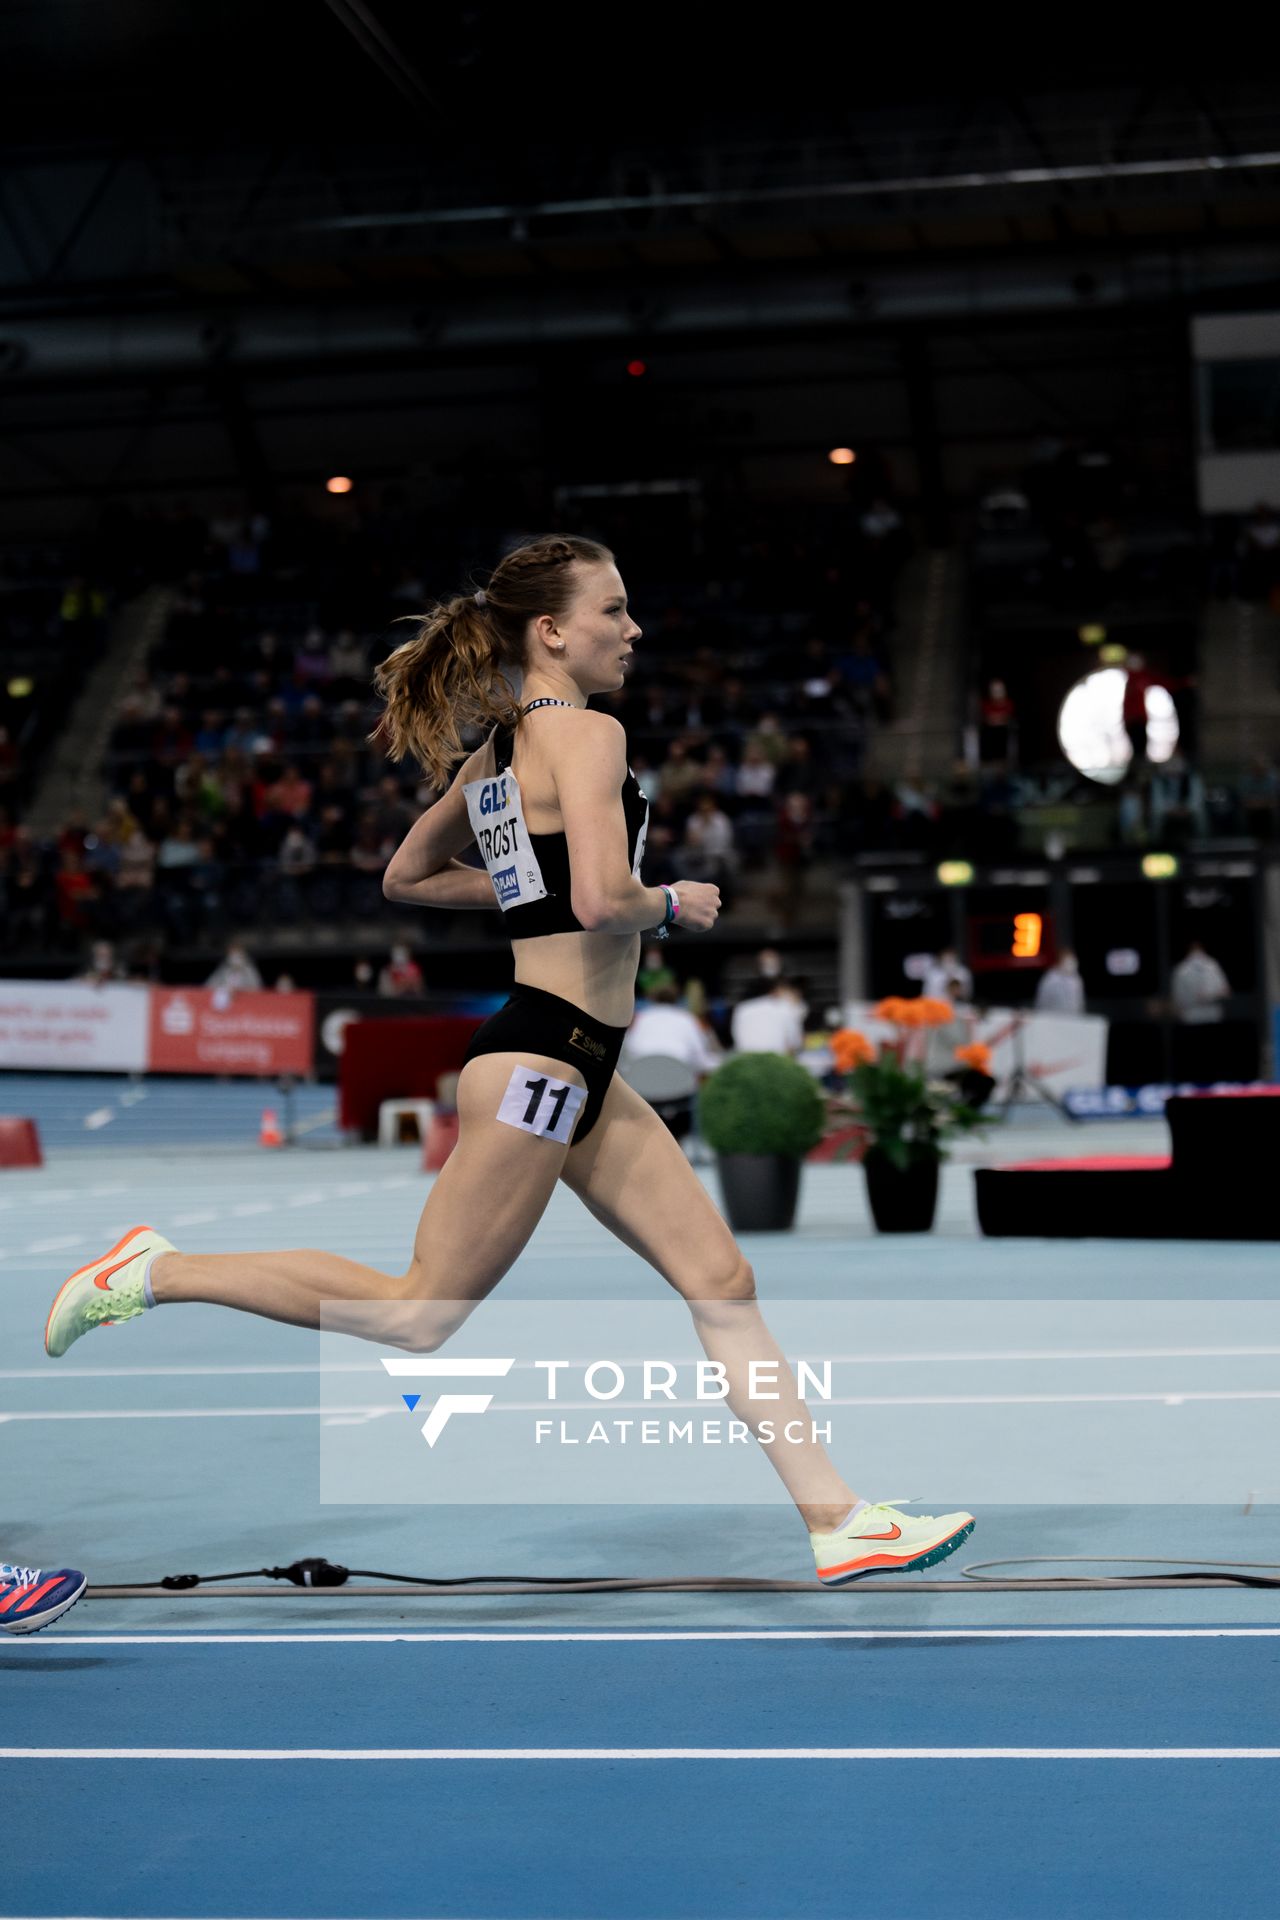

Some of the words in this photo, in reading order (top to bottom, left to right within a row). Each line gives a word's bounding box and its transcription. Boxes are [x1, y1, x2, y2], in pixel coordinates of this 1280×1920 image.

[479, 778, 507, 816] GLS
[479, 817, 518, 863] TROST
[526, 871, 536, 884] 84
[522, 1078, 571, 1132] 11
